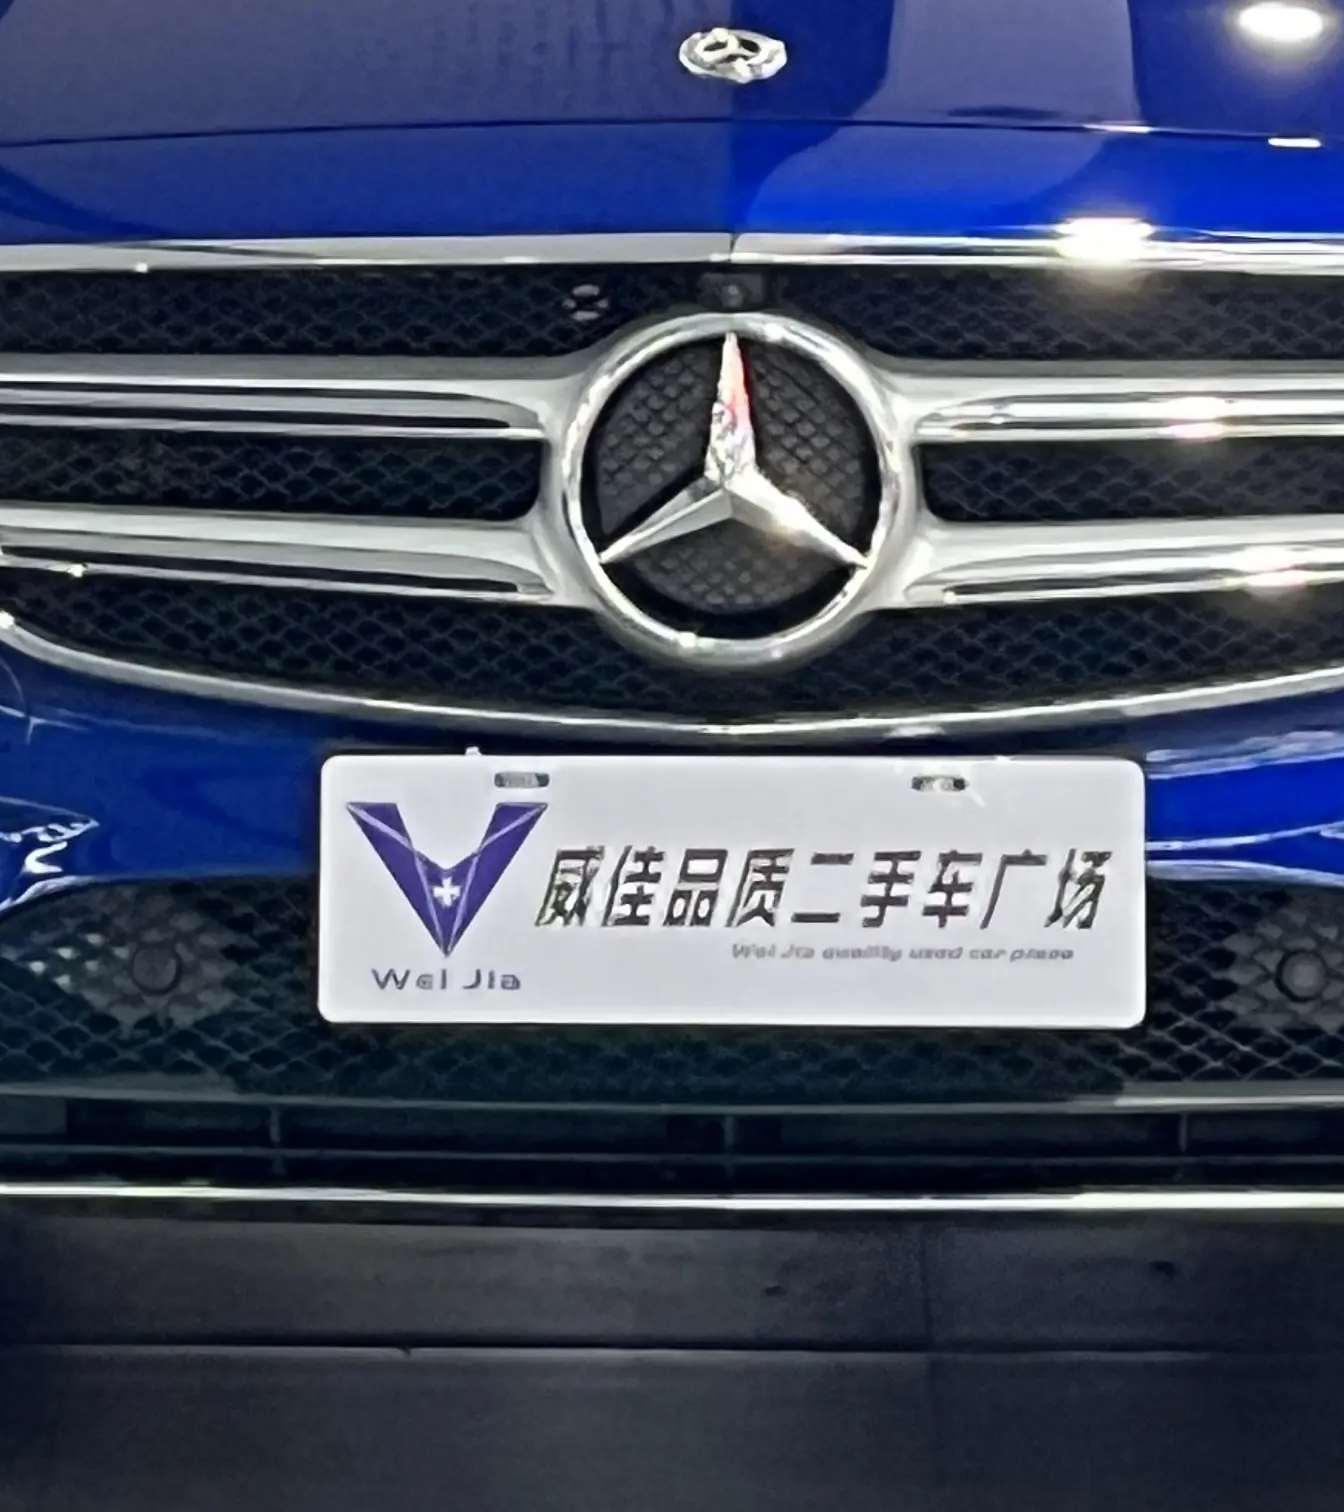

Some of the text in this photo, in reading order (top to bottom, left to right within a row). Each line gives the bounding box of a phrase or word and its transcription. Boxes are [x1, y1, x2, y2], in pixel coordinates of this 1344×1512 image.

[533, 844, 1115, 929] 威佳品质二手车广场
[370, 967, 523, 991] Wei Jia
